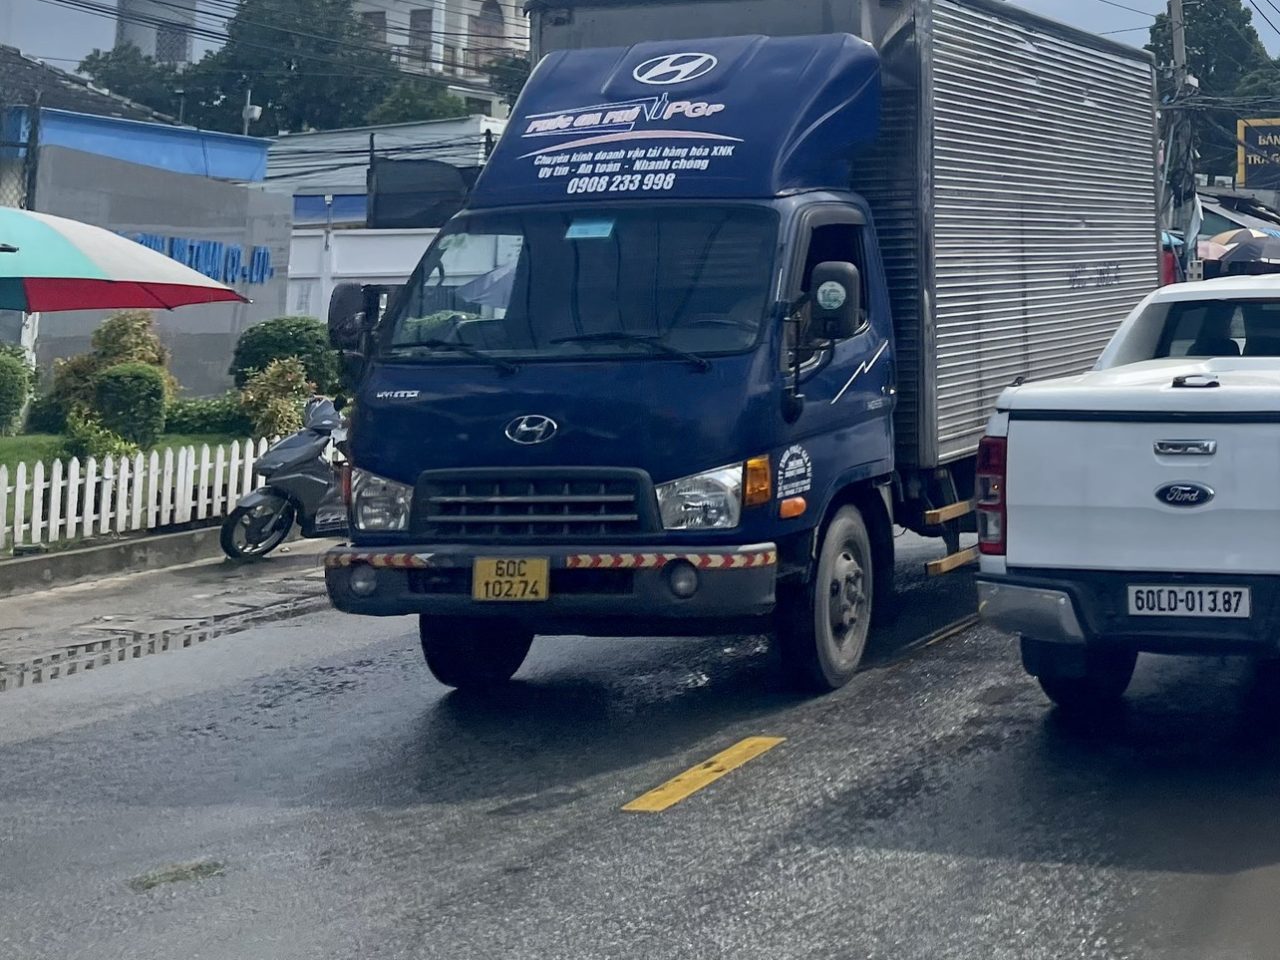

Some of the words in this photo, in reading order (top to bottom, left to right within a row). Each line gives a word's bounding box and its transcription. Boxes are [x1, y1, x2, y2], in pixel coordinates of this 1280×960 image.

[570, 151, 594, 163] kinh
[594, 149, 626, 161] doanh
[662, 145, 689, 158] hàng
[711, 145, 735, 157] XNK
[538, 166, 554, 179] Uy
[577, 162, 594, 174] An
[633, 159, 671, 171] Nhanh
[671, 157, 710, 171] chóng
[566, 175, 610, 194] 0908
[609, 173, 642, 192] 233
[642, 172, 677, 191] 998
[1166, 485, 1199, 502] Ford
[495, 559, 527, 577] 60C
[483, 580, 540, 598] 102.74
[1134, 590, 1243, 614] 60LD-013.87
